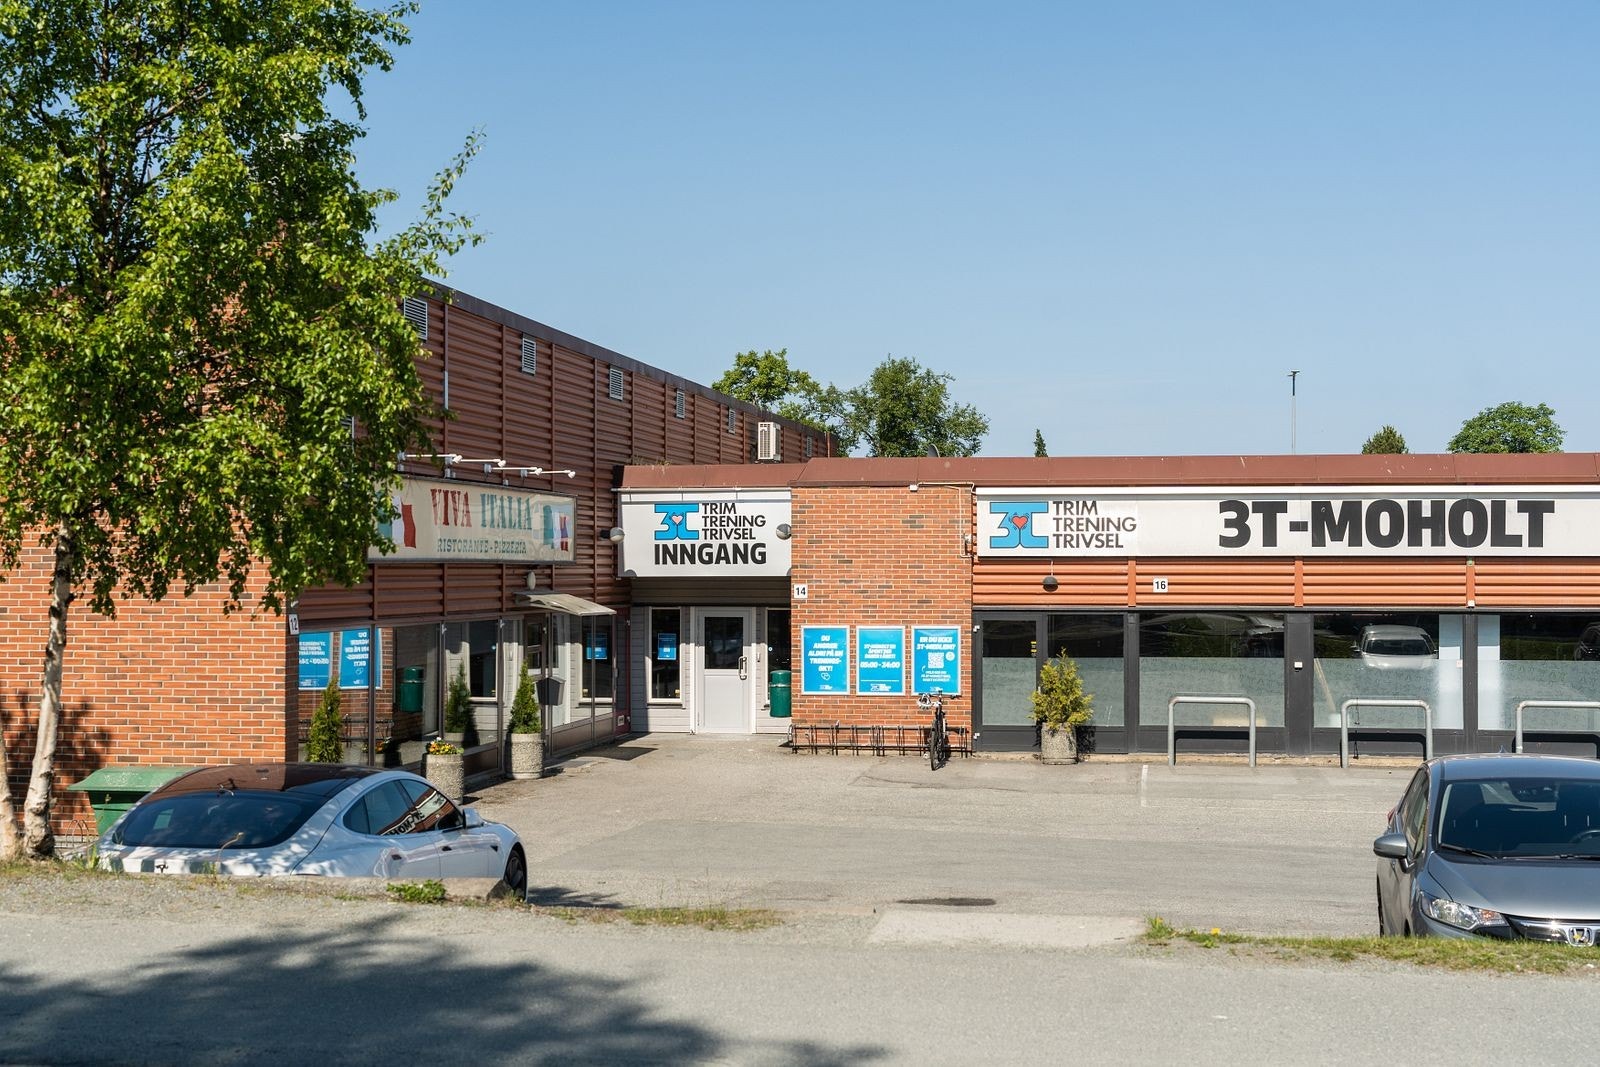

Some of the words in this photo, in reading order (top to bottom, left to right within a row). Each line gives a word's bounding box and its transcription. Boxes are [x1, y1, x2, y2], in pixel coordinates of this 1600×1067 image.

[430, 488, 472, 528] VIVA
[480, 493, 532, 530] ITALIA
[702, 502, 737, 515] TRIM
[1053, 501, 1098, 516] TRIM
[702, 515, 766, 528] TRENING
[1053, 516, 1137, 533] TRENING
[1219, 499, 1555, 548] 3T-MOHOLT
[702, 528, 756, 540] TRIVSEL
[1053, 533, 1124, 549] TRIVSEL
[654, 542, 767, 565] INNGANG
[795, 587, 806, 596] 14
[1155, 580, 1166, 590] 16
[290, 617, 298, 631] 12
